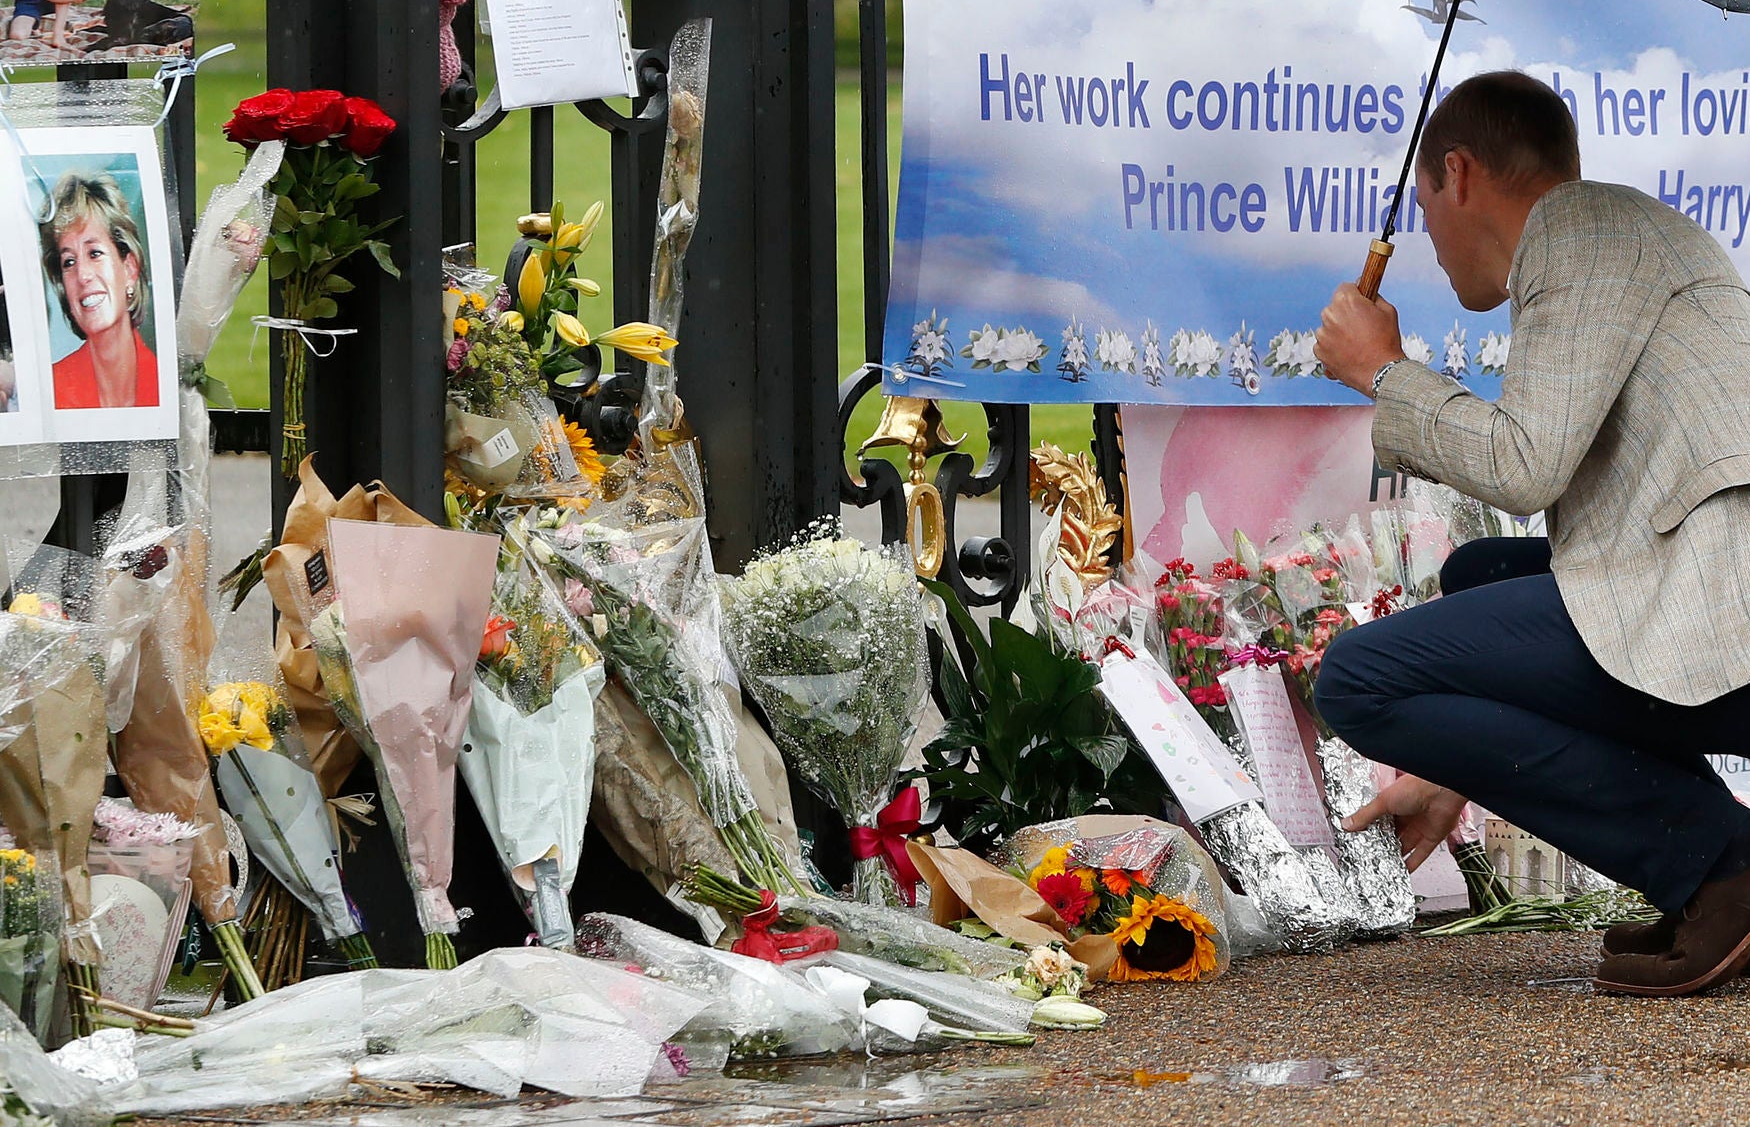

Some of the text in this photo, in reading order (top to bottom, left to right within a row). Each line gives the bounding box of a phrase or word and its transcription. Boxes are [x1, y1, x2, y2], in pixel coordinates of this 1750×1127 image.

[980, 52, 1044, 122] Her
[1056, 62, 1148, 130] work
[1166, 66, 1404, 136] continues
[1594, 71, 1665, 138] her
[1122, 162, 1266, 234] Prince
